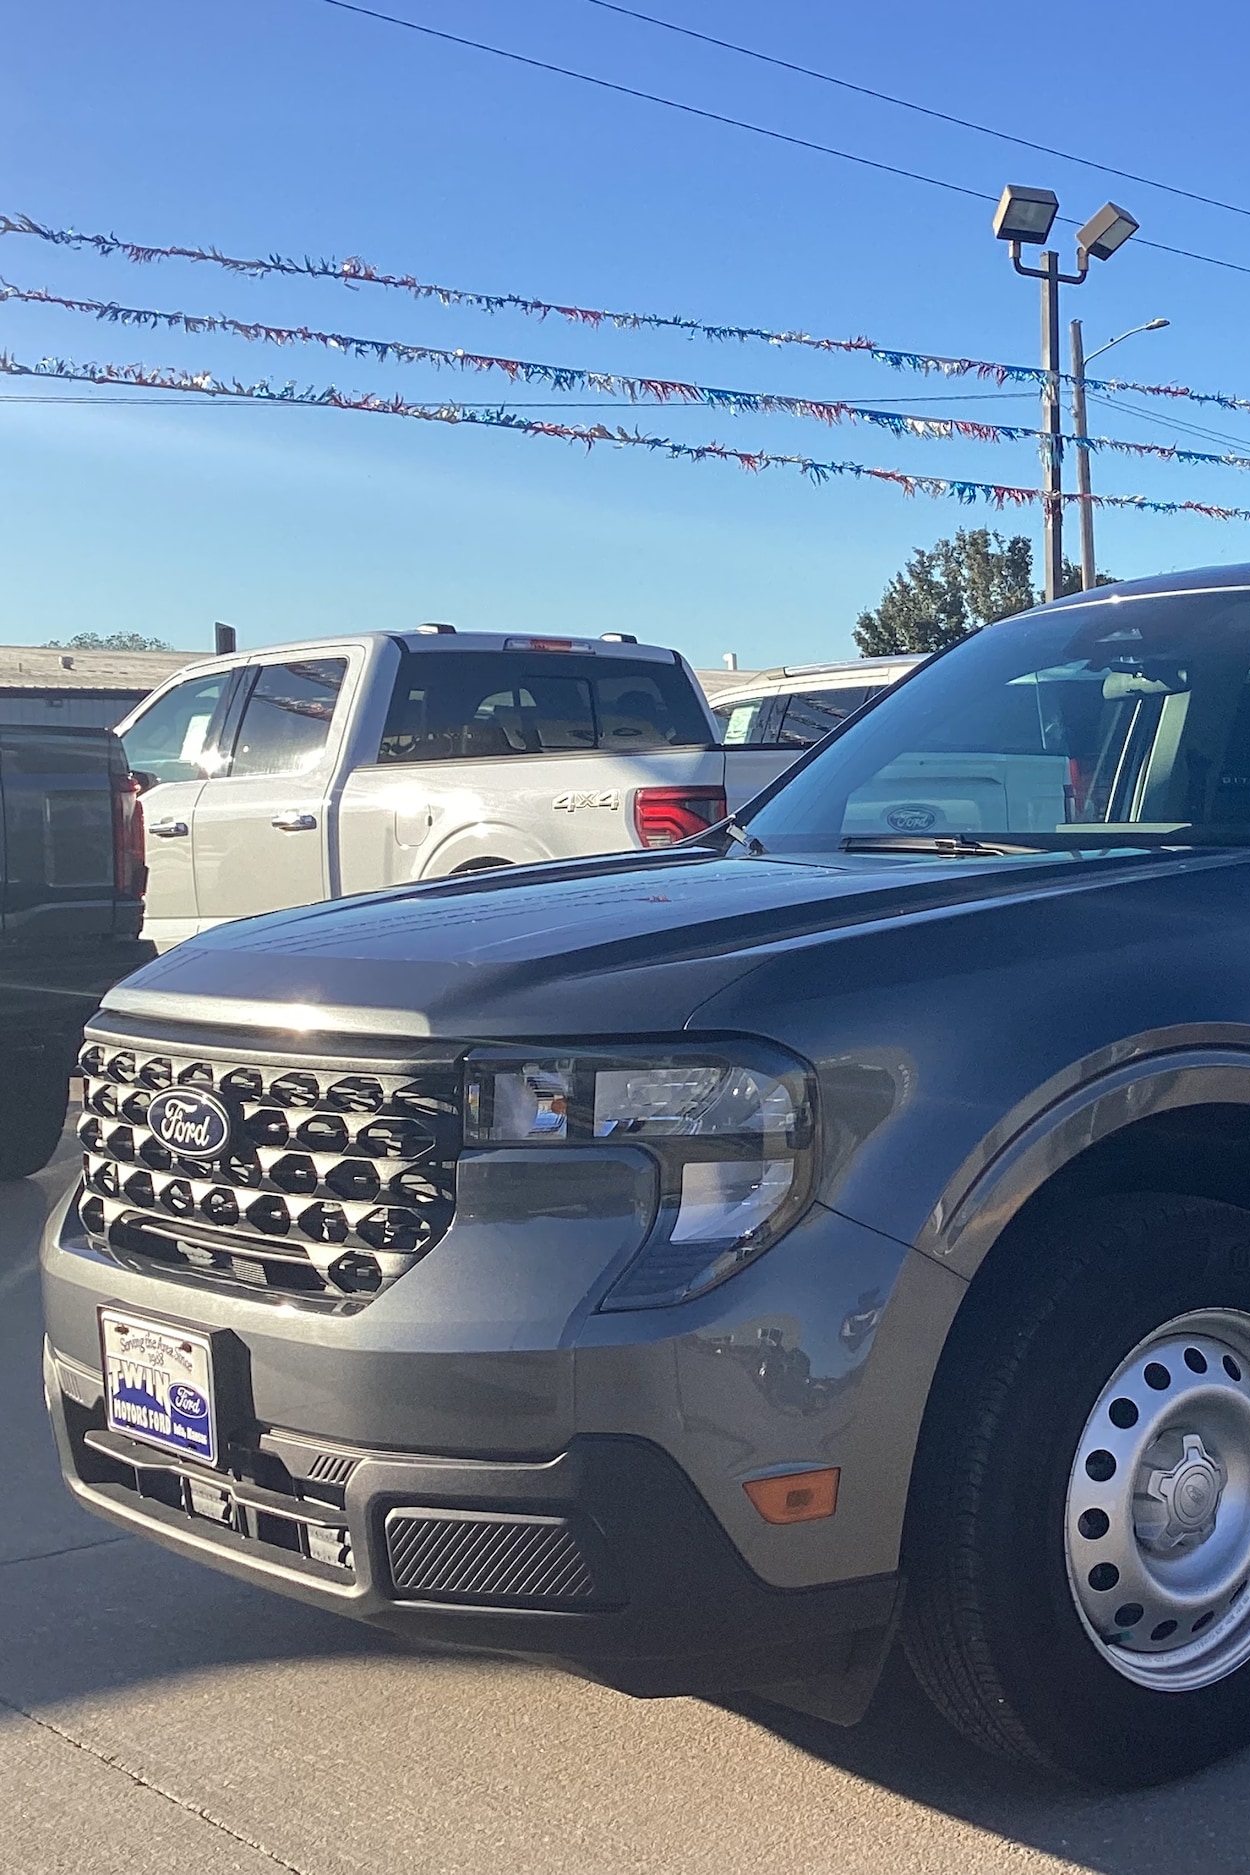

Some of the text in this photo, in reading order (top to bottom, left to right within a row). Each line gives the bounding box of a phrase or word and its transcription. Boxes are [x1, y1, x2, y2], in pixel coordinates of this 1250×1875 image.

[897, 810, 929, 828] Ford
[161, 1098, 210, 1147] Ford
[120, 1332, 193, 1372] Serving the Area Since
[108, 1356, 171, 1417] TWIN
[175, 1387, 200, 1413] Ford
[149, 1409, 171, 1435] FORD
